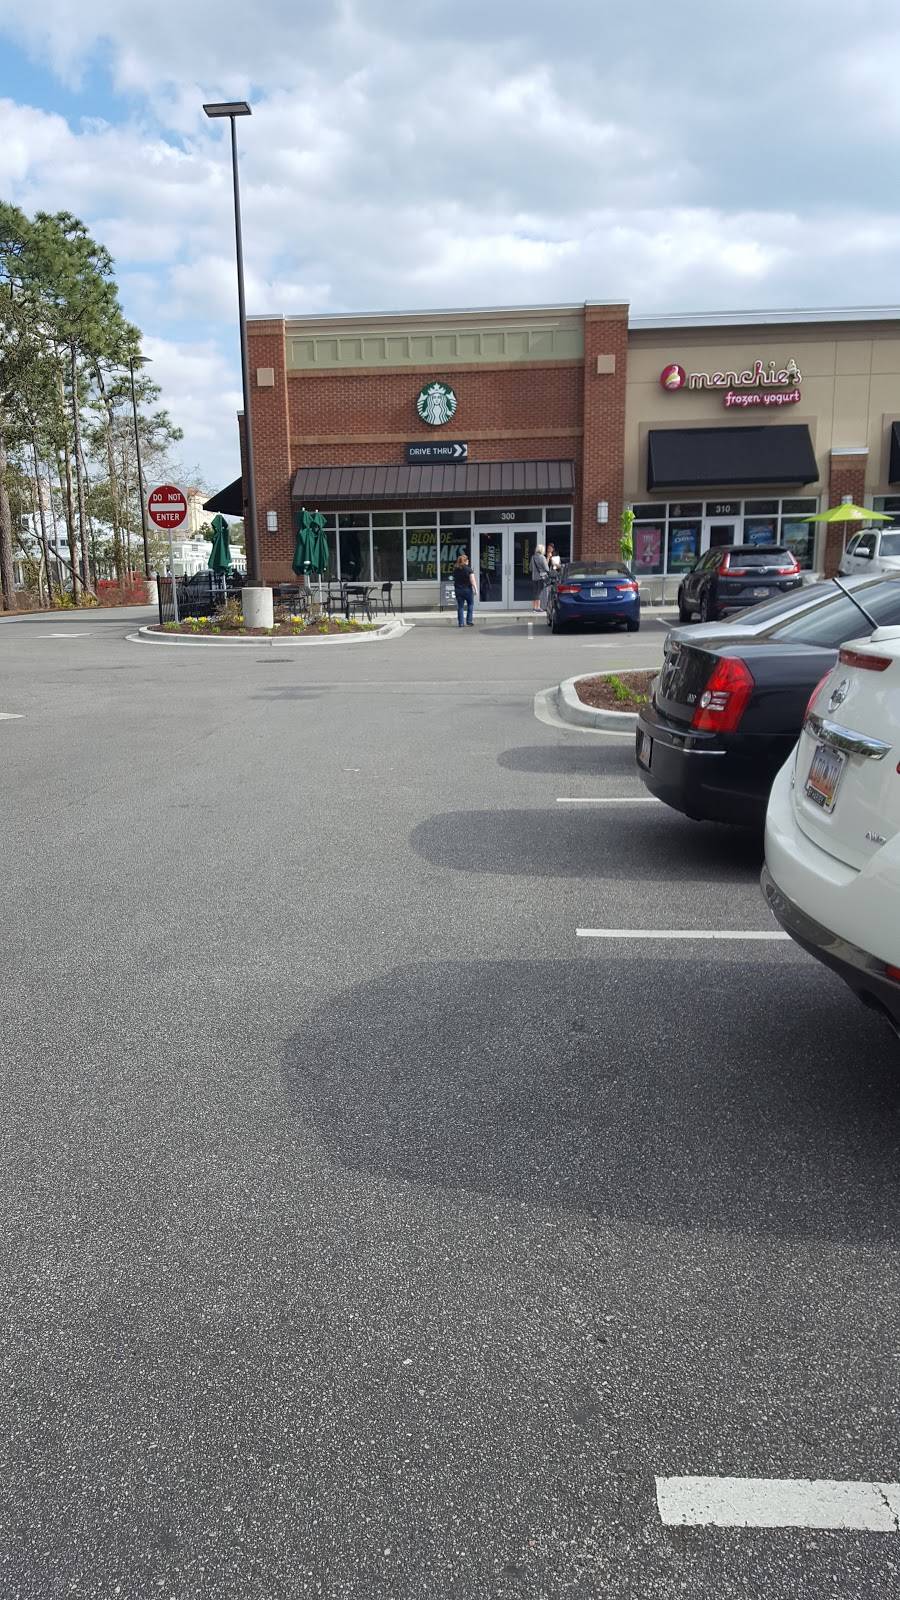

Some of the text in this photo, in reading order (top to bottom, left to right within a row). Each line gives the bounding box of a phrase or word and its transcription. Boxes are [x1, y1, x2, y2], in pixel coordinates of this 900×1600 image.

[689, 359, 802, 388] menchie's
[725, 389, 800, 406] frozen yogurt
[409, 447, 453, 456] DRIVE THRU
[168, 493, 181, 501] NOT
[715, 504, 731, 513] 310
[156, 513, 180, 521] ENTER
[501, 512, 515, 520] 300
